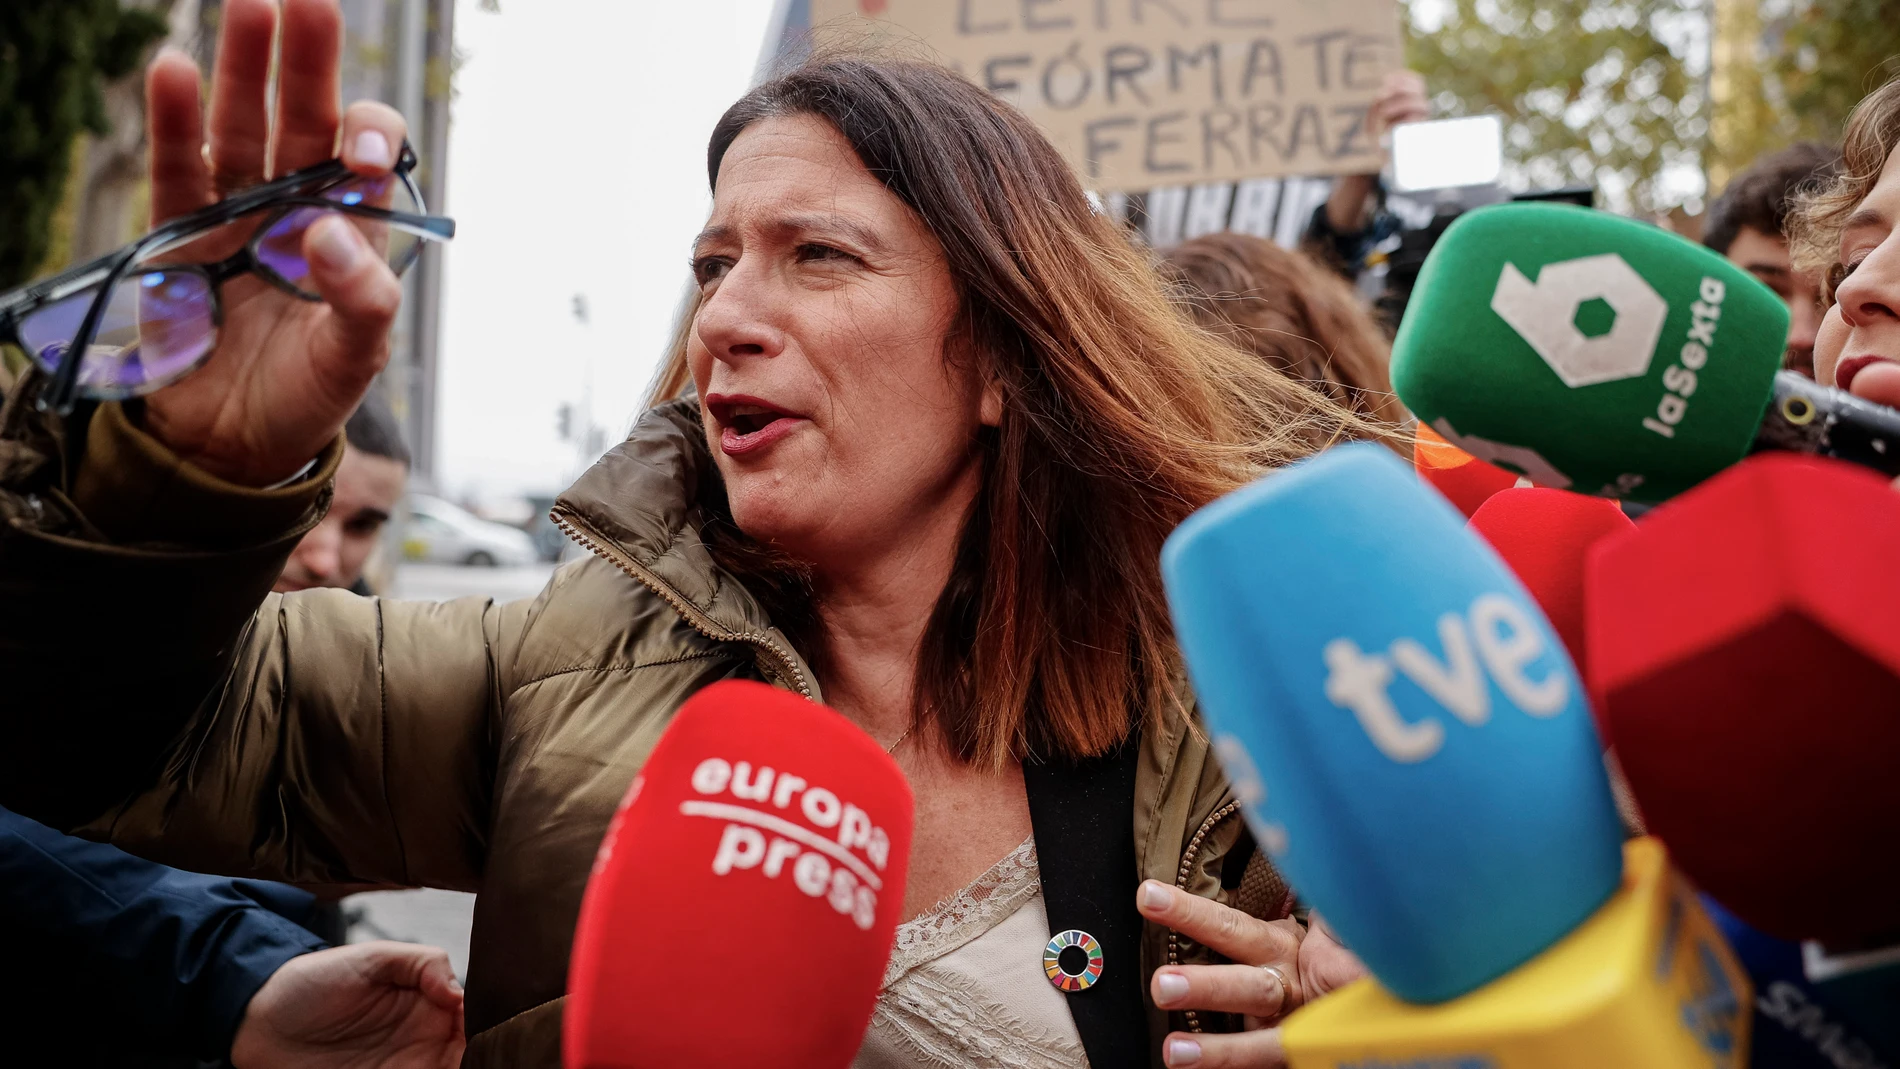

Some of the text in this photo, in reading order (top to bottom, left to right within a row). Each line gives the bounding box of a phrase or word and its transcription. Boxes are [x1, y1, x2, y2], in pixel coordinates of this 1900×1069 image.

[952, 26, 1397, 112] FÓRMATE
[1083, 102, 1374, 178] FERRAZ
[1642, 275, 1726, 438] laSexta
[1321, 592, 1571, 764] tve
[690, 757, 891, 872] europa
[711, 823, 878, 931] press
